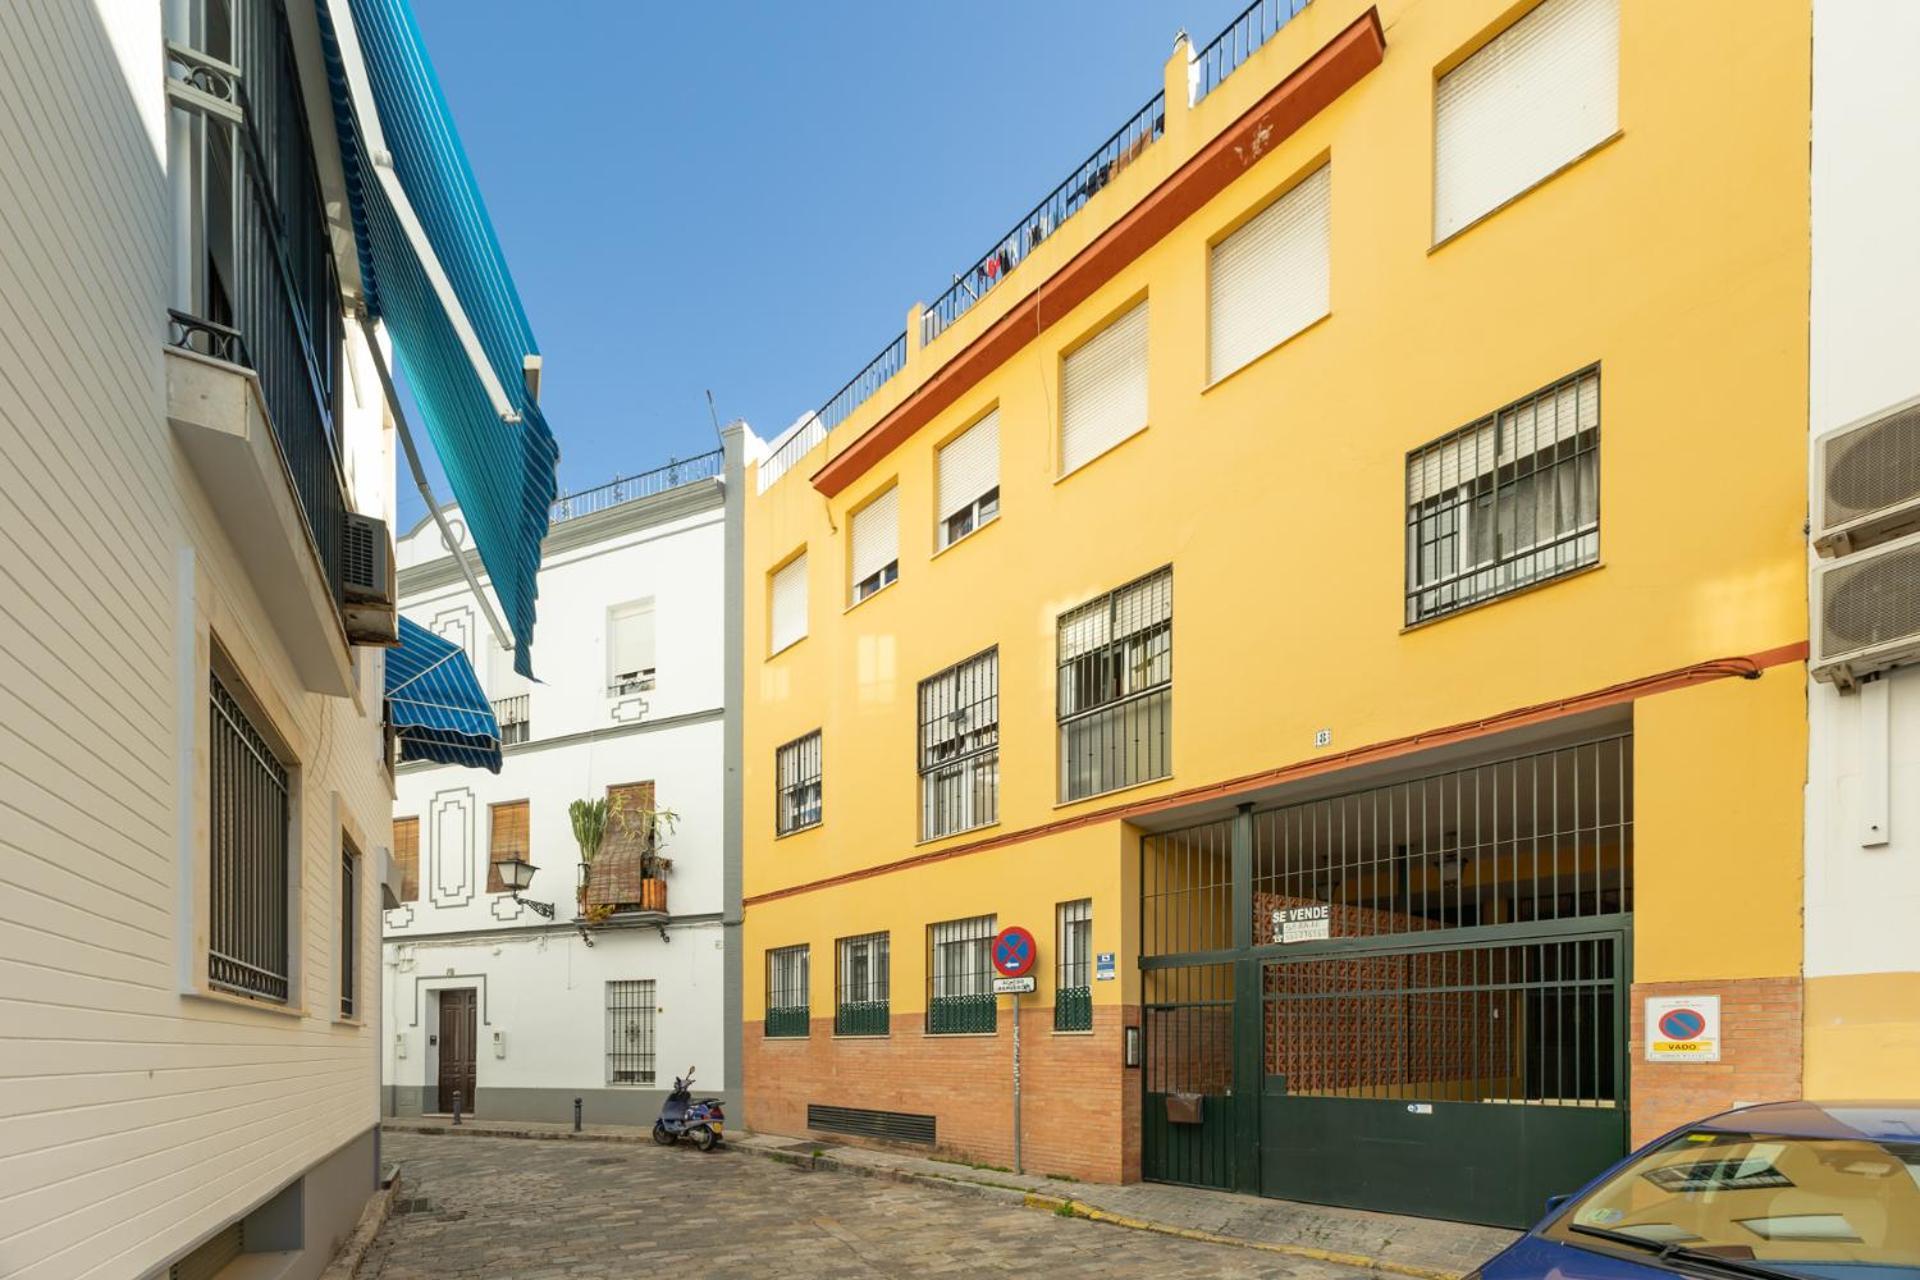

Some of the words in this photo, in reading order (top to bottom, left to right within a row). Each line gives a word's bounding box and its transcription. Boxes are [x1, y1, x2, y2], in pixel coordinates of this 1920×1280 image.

[1272, 910, 1287, 924] SE
[1290, 905, 1329, 921] VENDE
[1668, 1043, 1697, 1051] VADO
